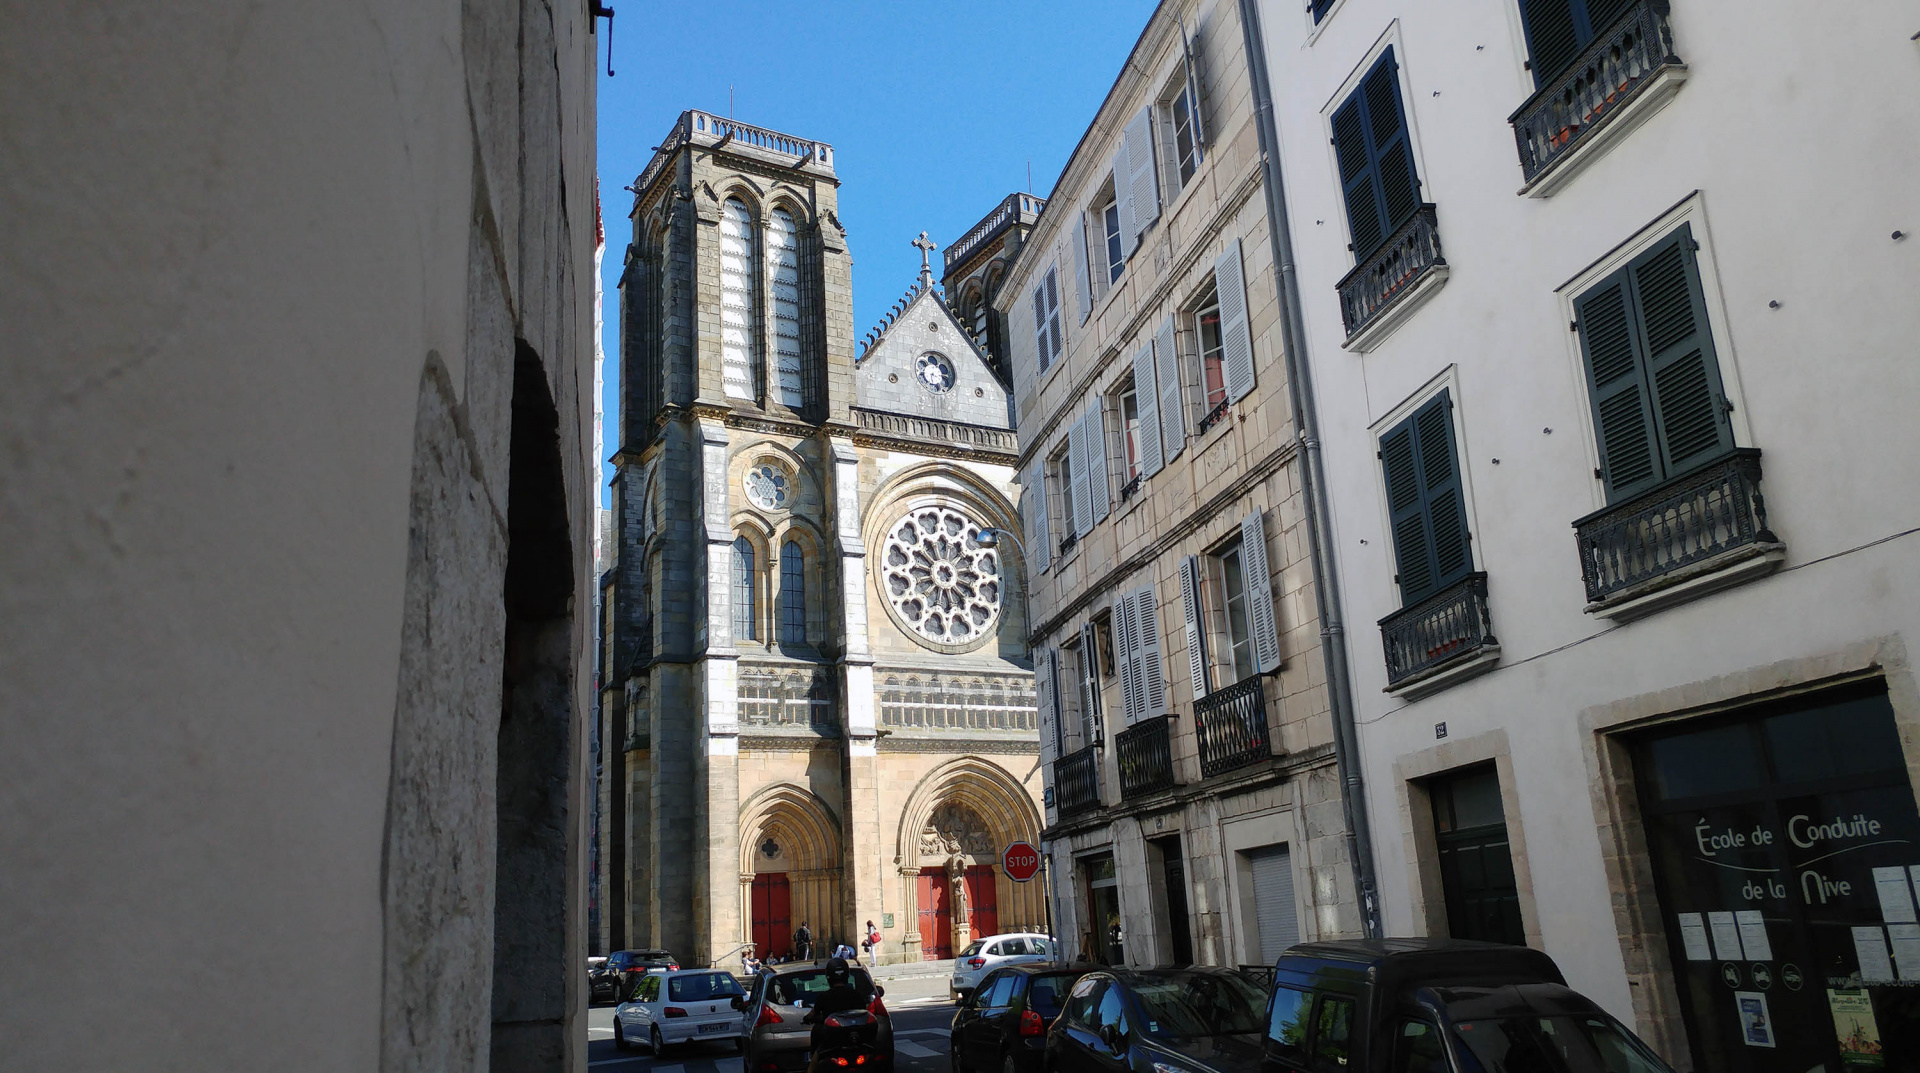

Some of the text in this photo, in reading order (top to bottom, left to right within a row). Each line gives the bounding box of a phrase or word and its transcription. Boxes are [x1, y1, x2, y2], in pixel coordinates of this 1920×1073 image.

[1695, 814, 1881, 857] École de Conduite
[1008, 856, 1035, 867] STOP
[1742, 880, 1763, 900] de
[1768, 879, 1786, 899] la
